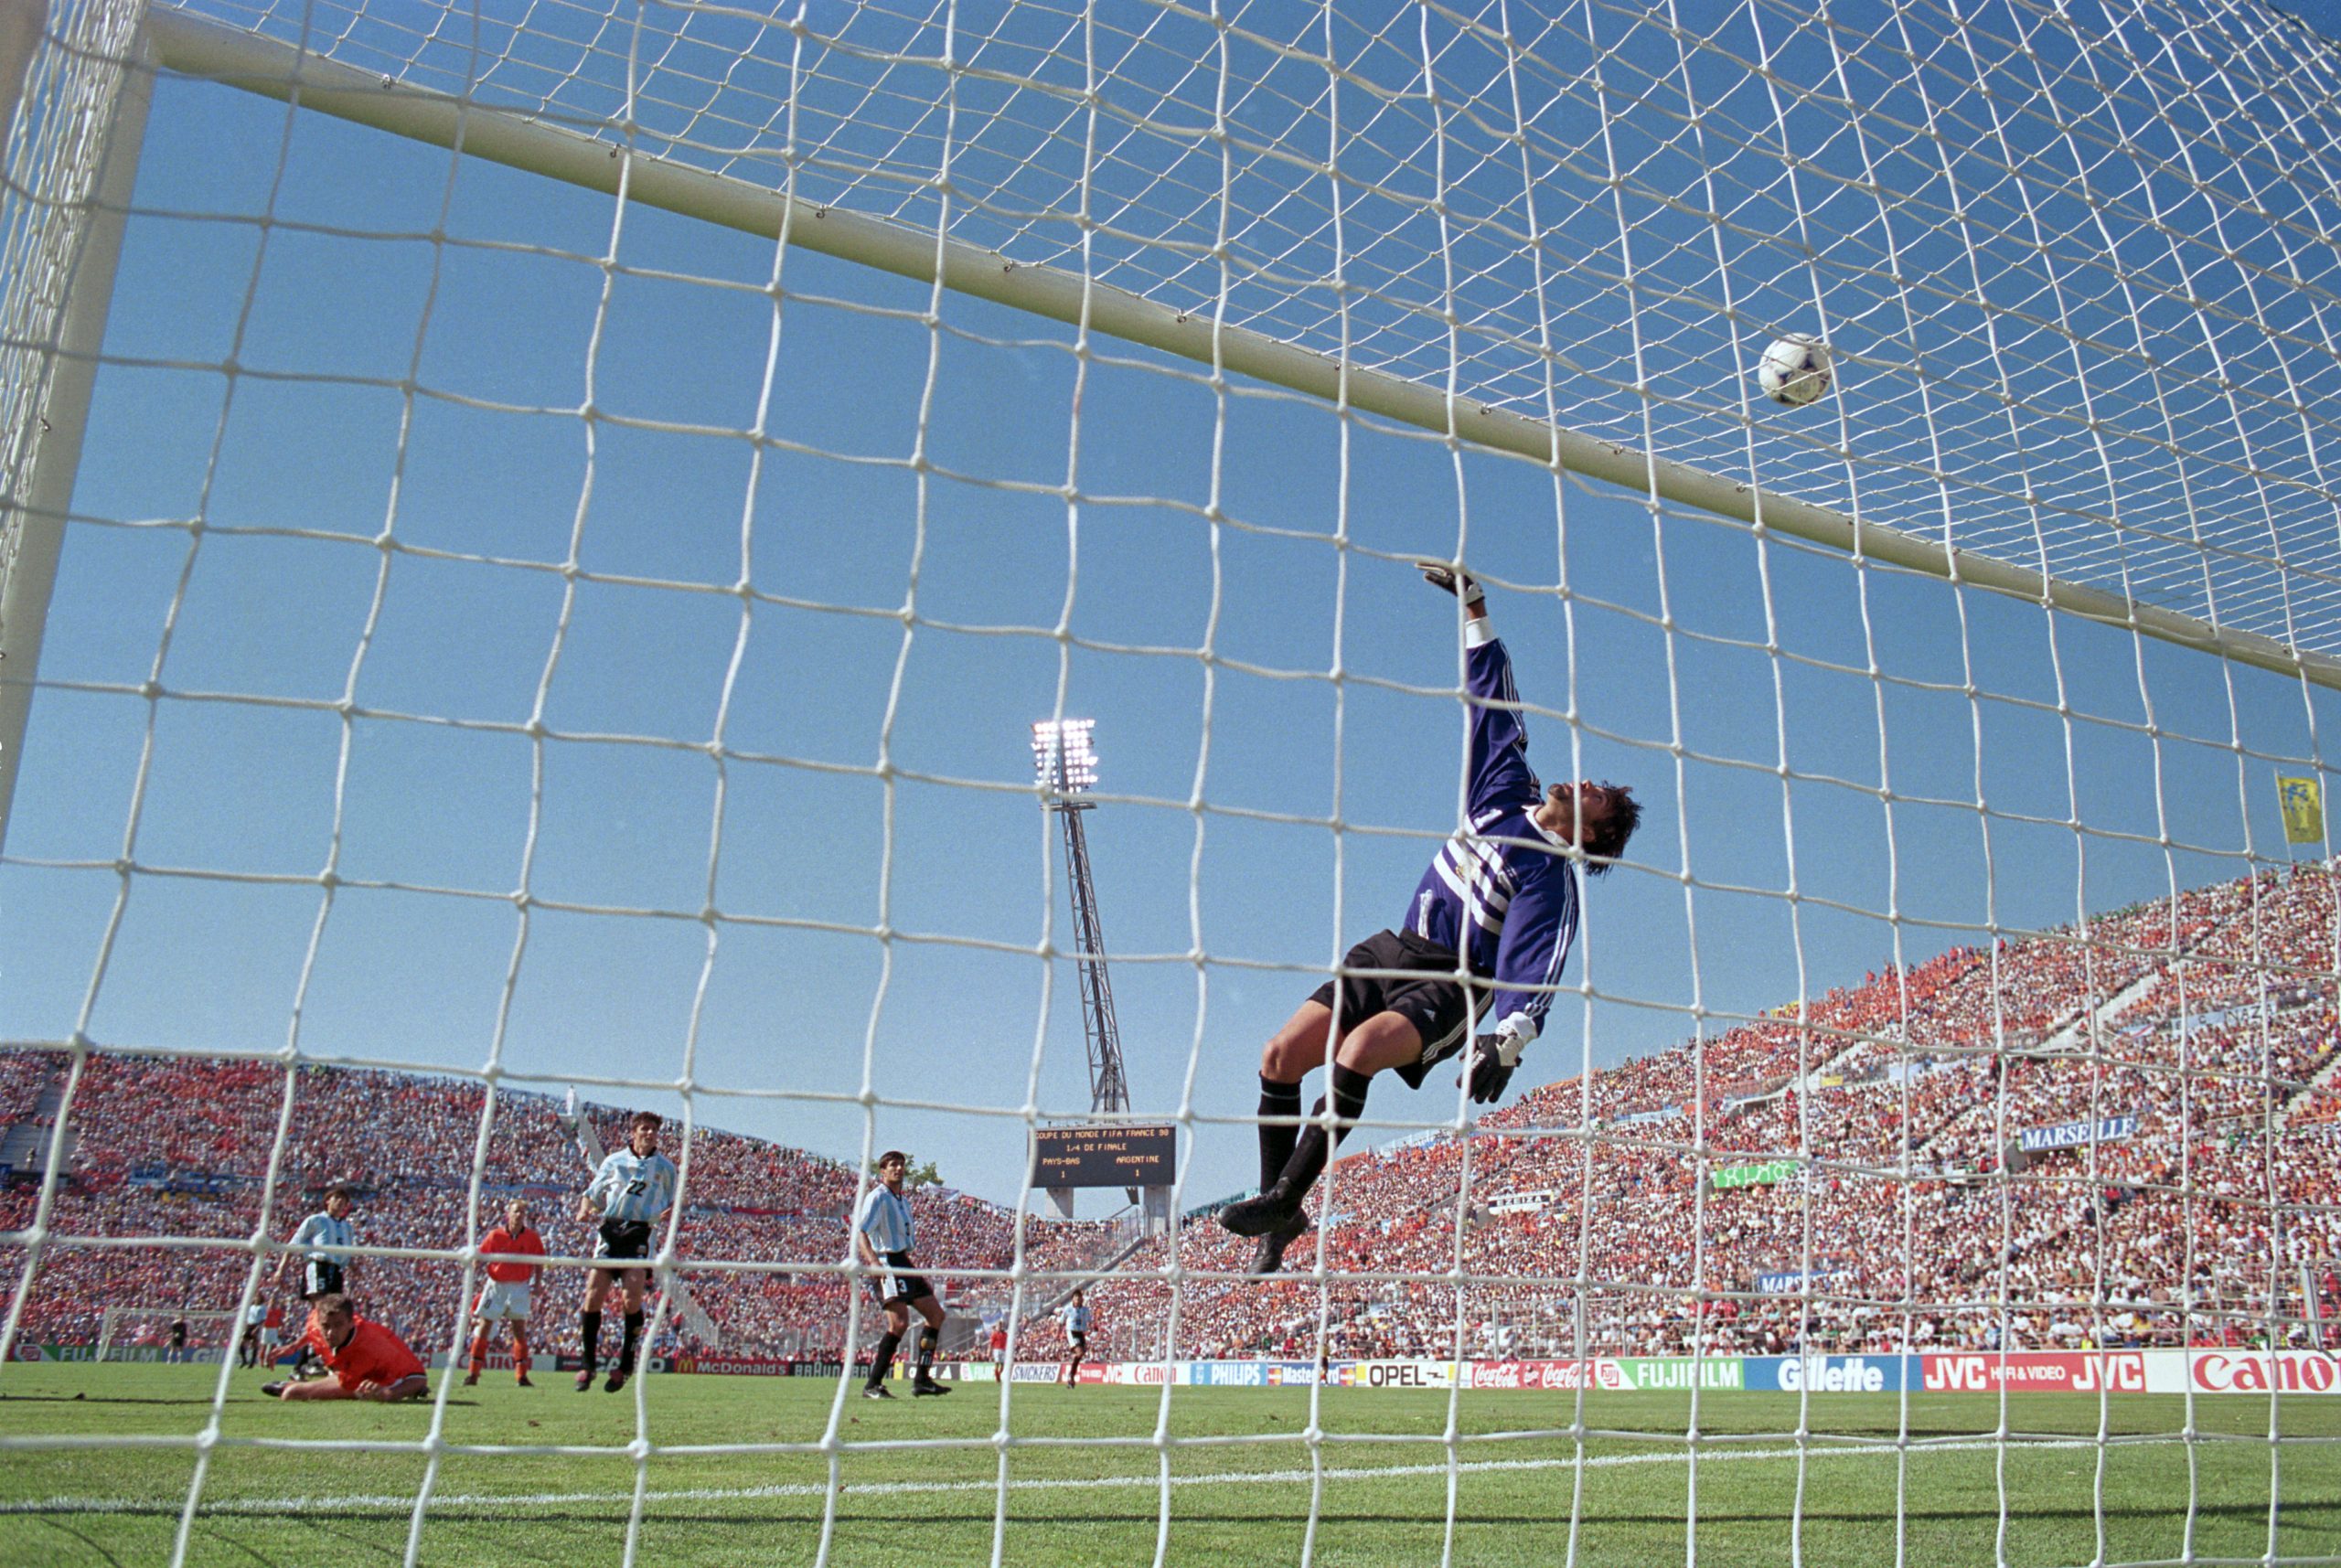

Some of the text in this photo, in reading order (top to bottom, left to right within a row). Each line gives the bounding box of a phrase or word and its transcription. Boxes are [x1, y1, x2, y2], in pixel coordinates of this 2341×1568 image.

[1035, 1131, 1058, 1139] COUPE
[1075, 1130, 1098, 1138] MONDE
[1103, 1129, 1123, 1137] FIFA
[1126, 1128, 1155, 1136] FRANCE
[1066, 1143, 1127, 1152] 1/4 DE FINALE
[1042, 1157, 1081, 1166] PAYS-BAS
[1116, 1156, 1160, 1164] ARGENTINE
[1061, 1170, 1065, 1179] 1
[1135, 1168, 1140, 1177] 1
[626, 1180, 647, 1197] 22
[317, 1277, 326, 1290] 5
[897, 1278, 909, 1293] 3
[696, 1360, 786, 1375] McDonald's
[795, 1360, 840, 1378] BRAUN
[1012, 1365, 1058, 1381] SNICKERS
[1103, 1364, 1123, 1383] JVC
[1211, 1363, 1261, 1386] PHILIPS
[1369, 1365, 1427, 1386] OPEL
[1474, 1362, 1520, 1388] Coca-Cola
[1925, 1357, 1987, 1390] JVC
[2017, 1366, 2027, 1381] &
[2026, 1365, 2066, 1381] VIDEO
[2072, 1354, 2143, 1390] JVC
[2193, 1354, 2341, 1391] Cano
